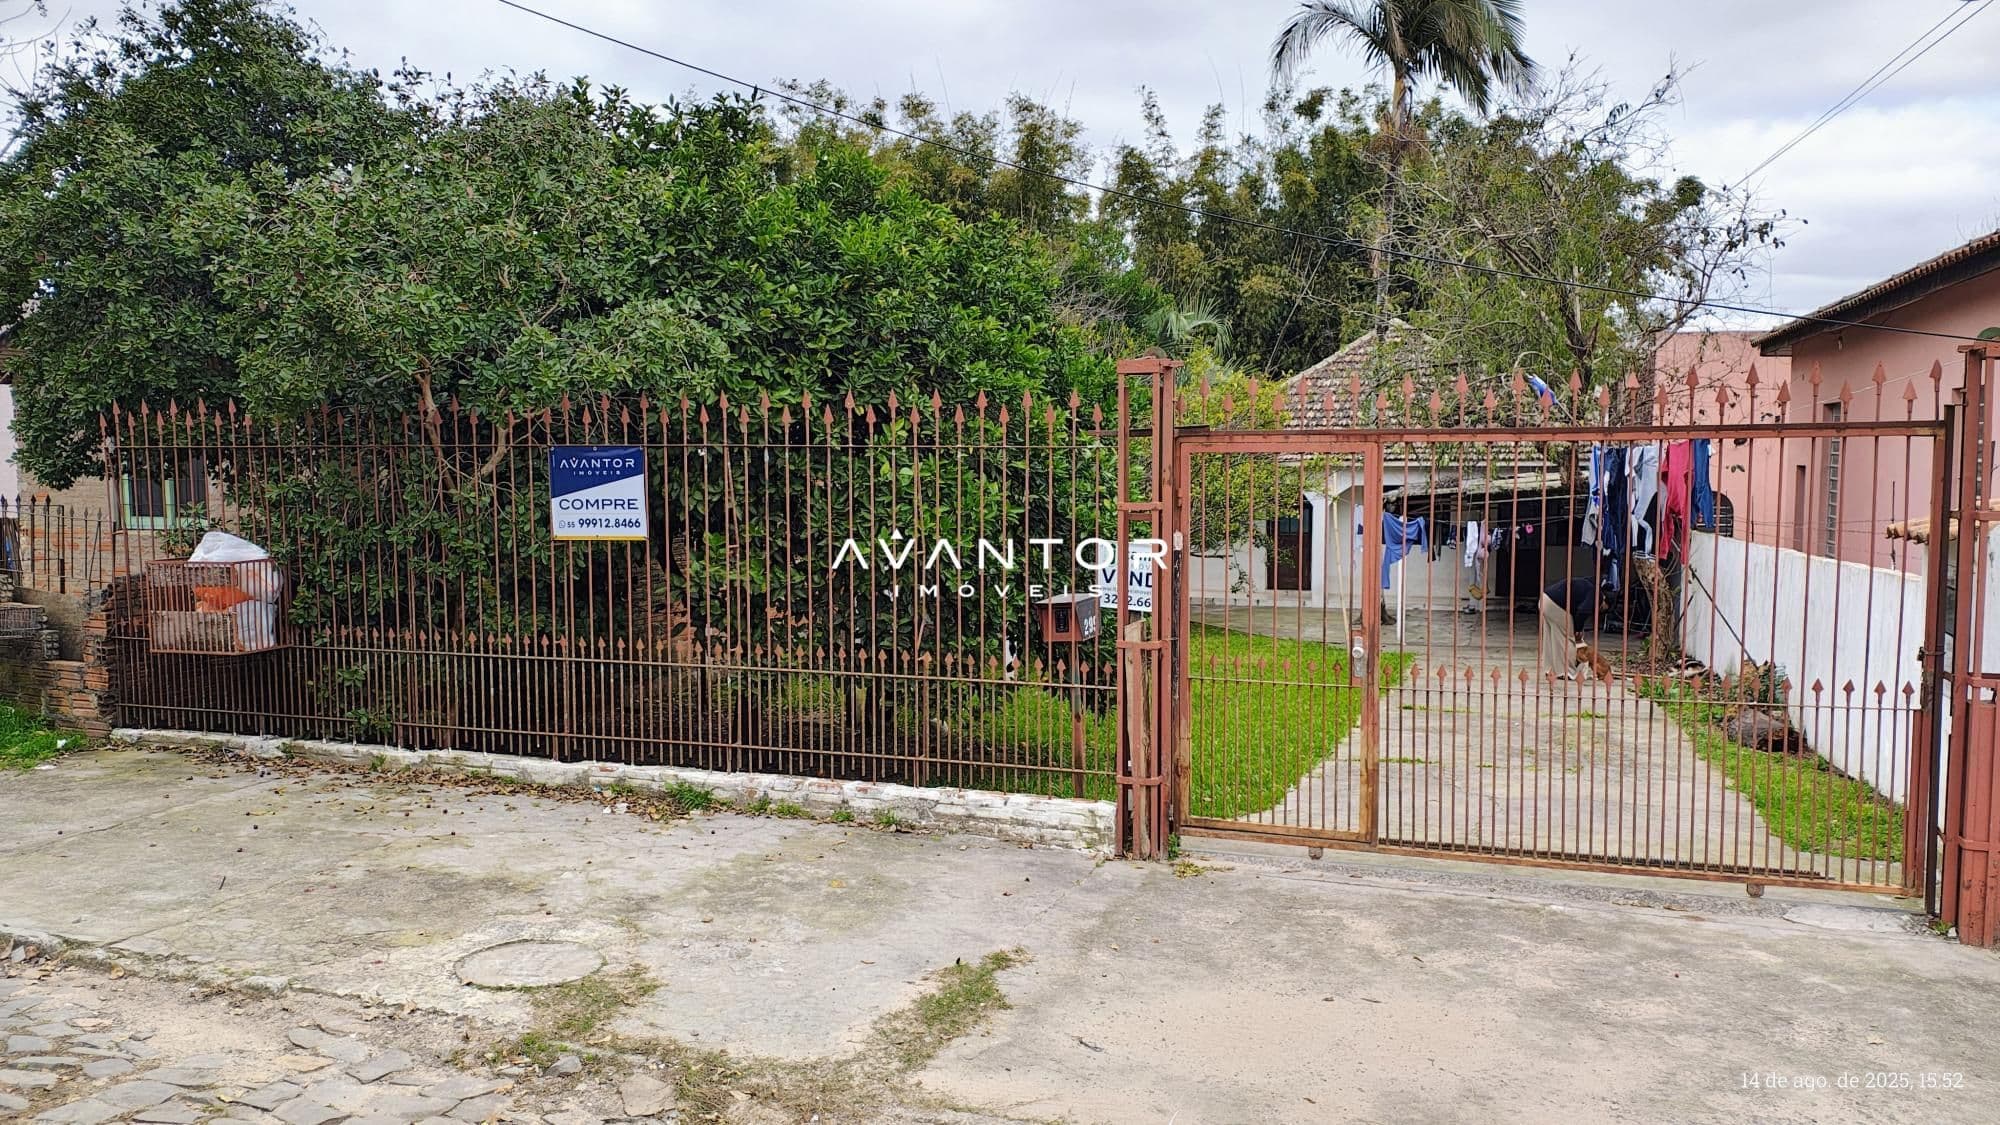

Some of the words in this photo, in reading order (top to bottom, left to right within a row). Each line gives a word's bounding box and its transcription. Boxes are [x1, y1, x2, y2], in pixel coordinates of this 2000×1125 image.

[560, 457, 635, 469] AVANTOR
[559, 498, 640, 511] COMPRE
[578, 518, 641, 529] 99912.8466
